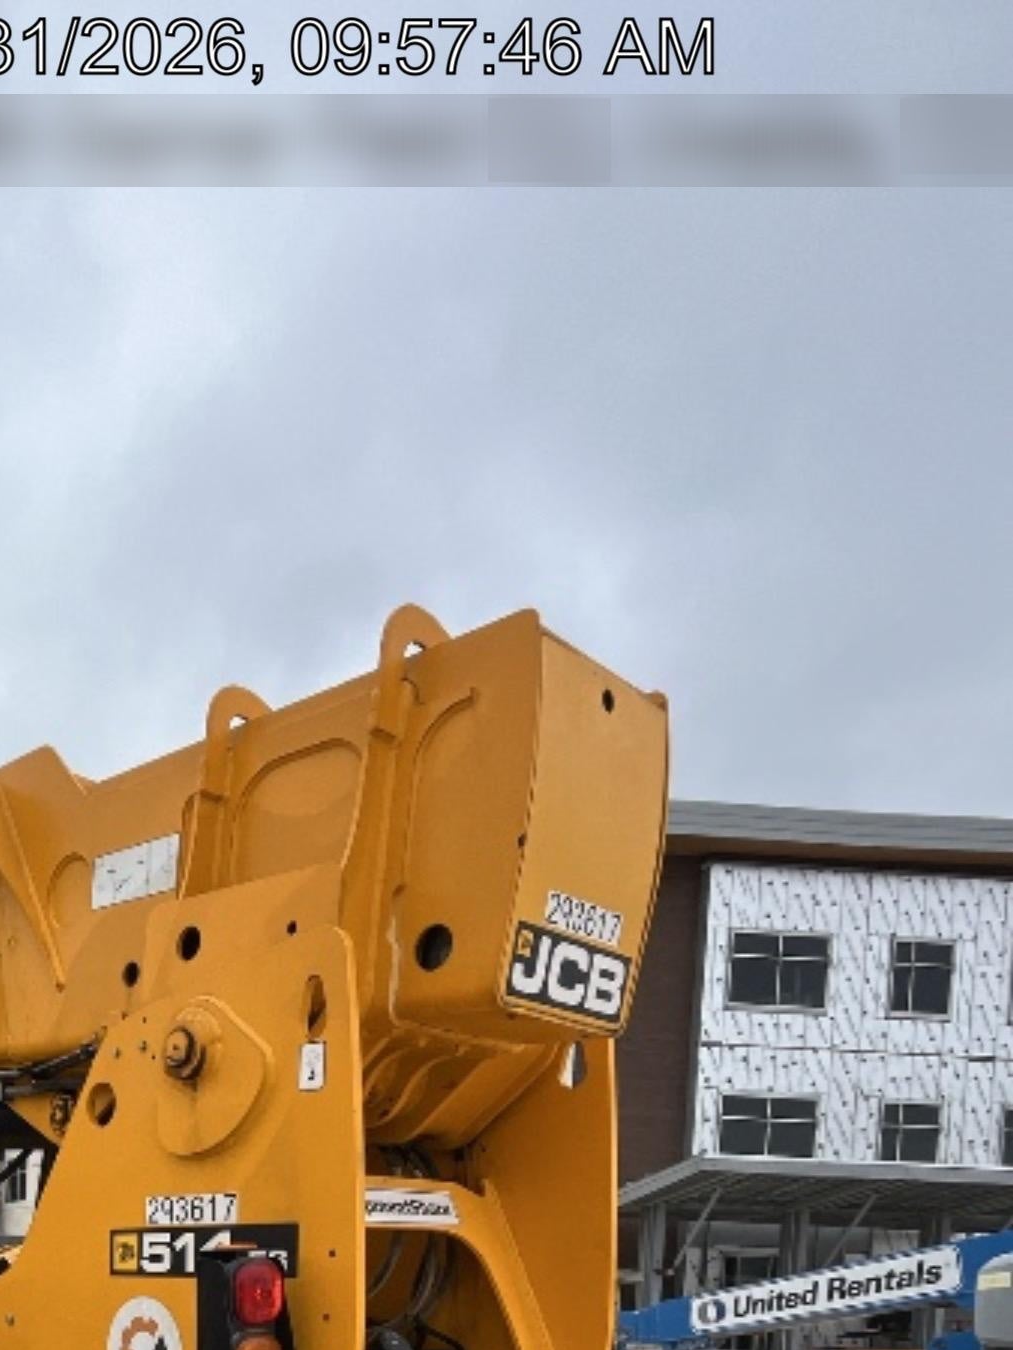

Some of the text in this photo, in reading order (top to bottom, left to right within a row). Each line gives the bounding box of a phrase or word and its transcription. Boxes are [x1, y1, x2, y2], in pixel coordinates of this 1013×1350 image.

[547, 893, 622, 942] 293617
[511, 934, 627, 1016] JCB
[148, 1193, 237, 1225] 293617
[733, 1260, 943, 1319] United Rentals
